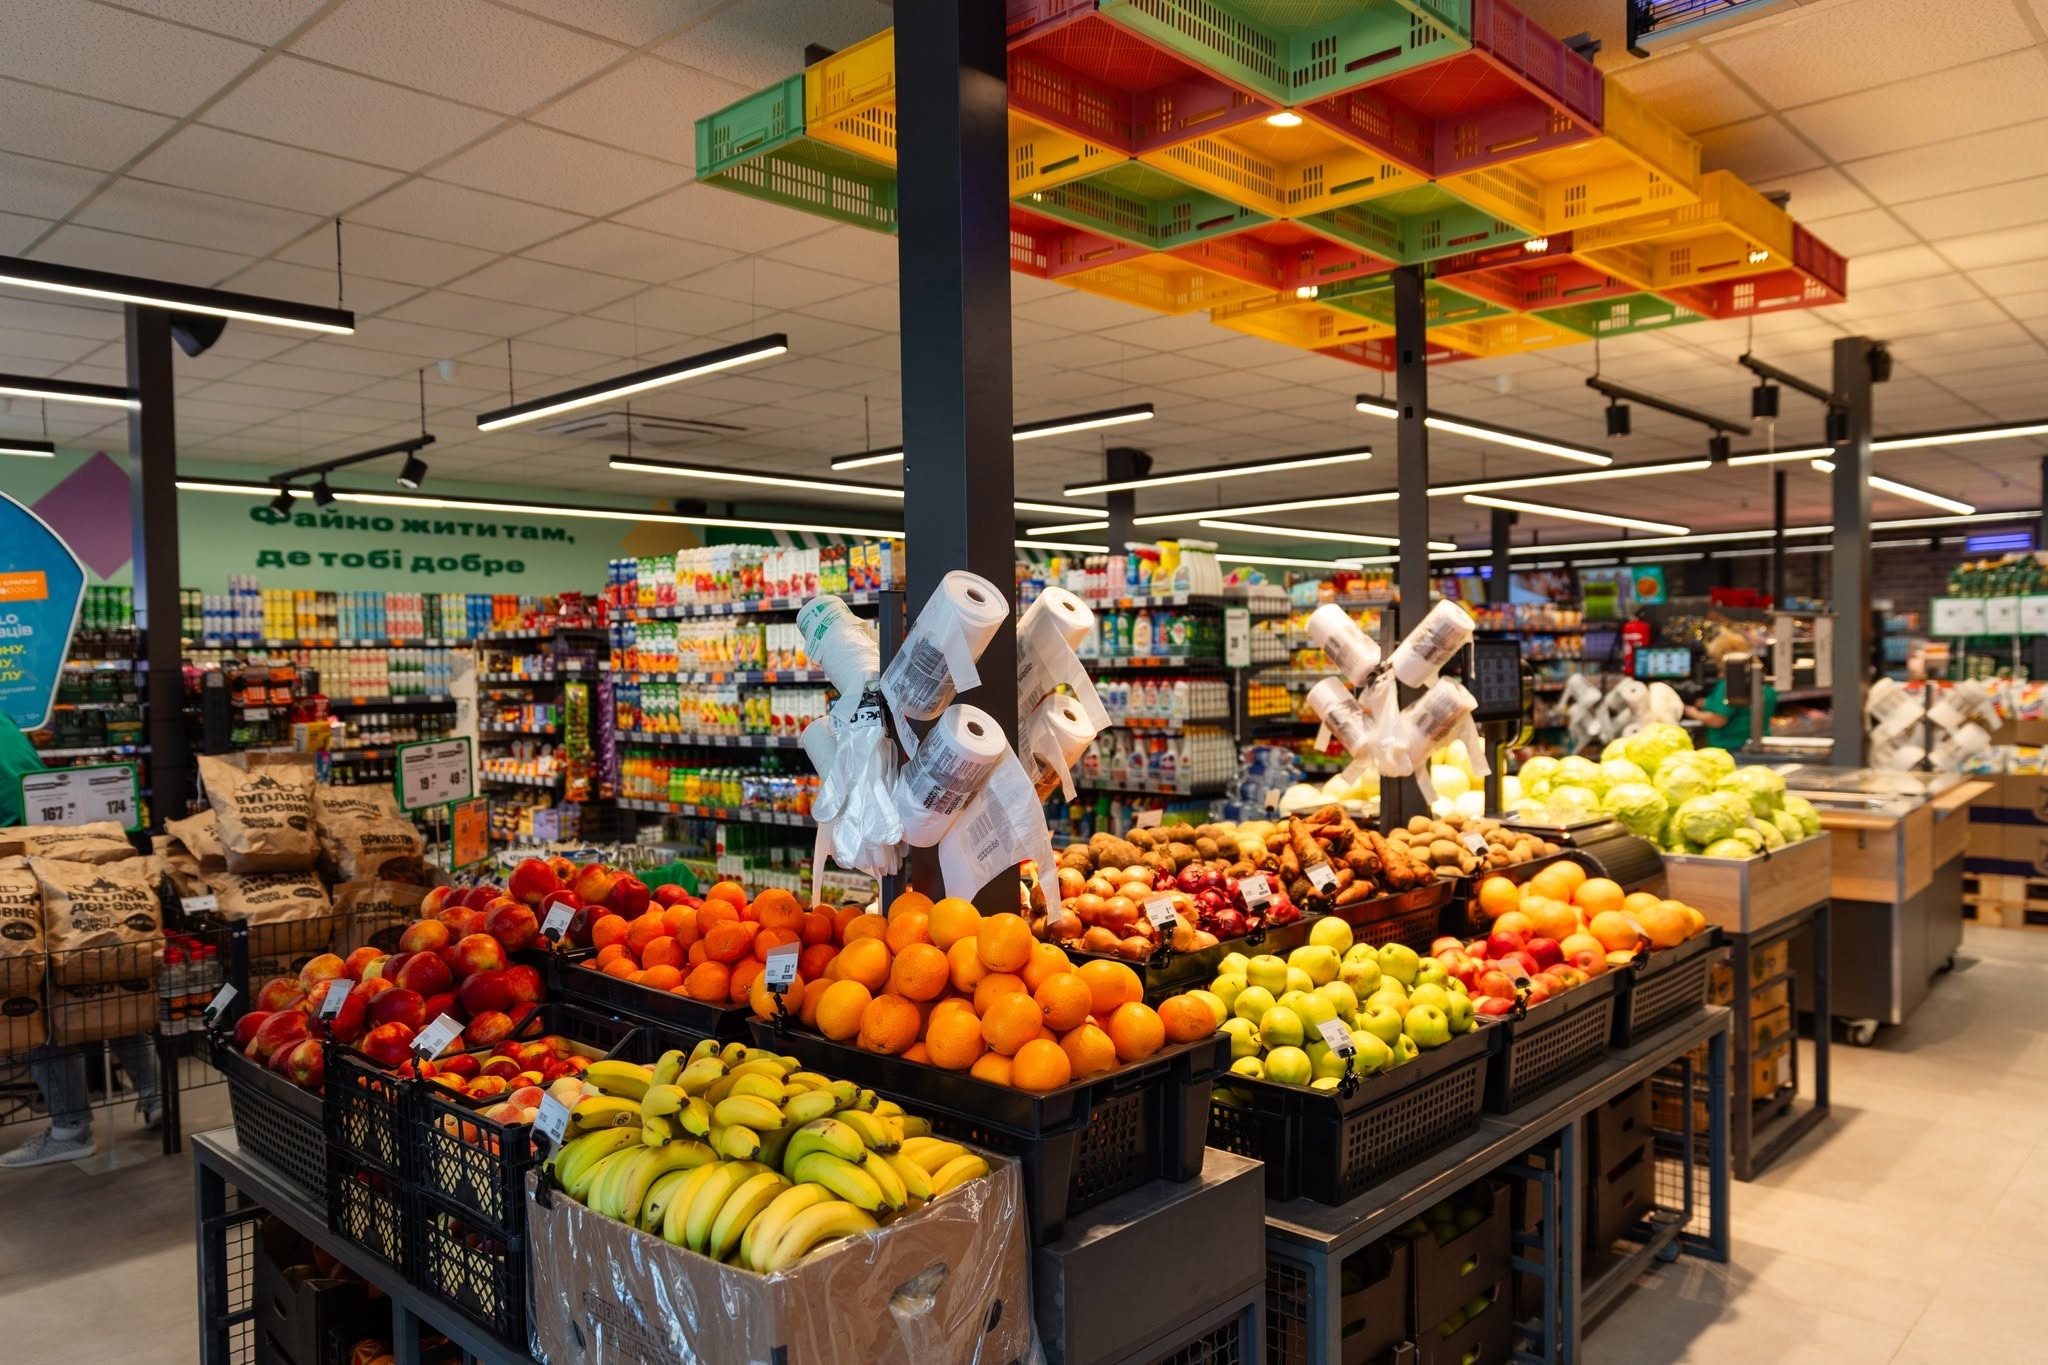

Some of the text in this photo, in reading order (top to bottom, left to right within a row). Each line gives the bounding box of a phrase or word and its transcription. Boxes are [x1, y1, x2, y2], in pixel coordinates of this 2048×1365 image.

[249, 504, 576, 544] Файно жити там,
[256, 548, 526, 577] де тобі добре
[41, 806, 64, 822] 167
[106, 799, 127, 815] 174
